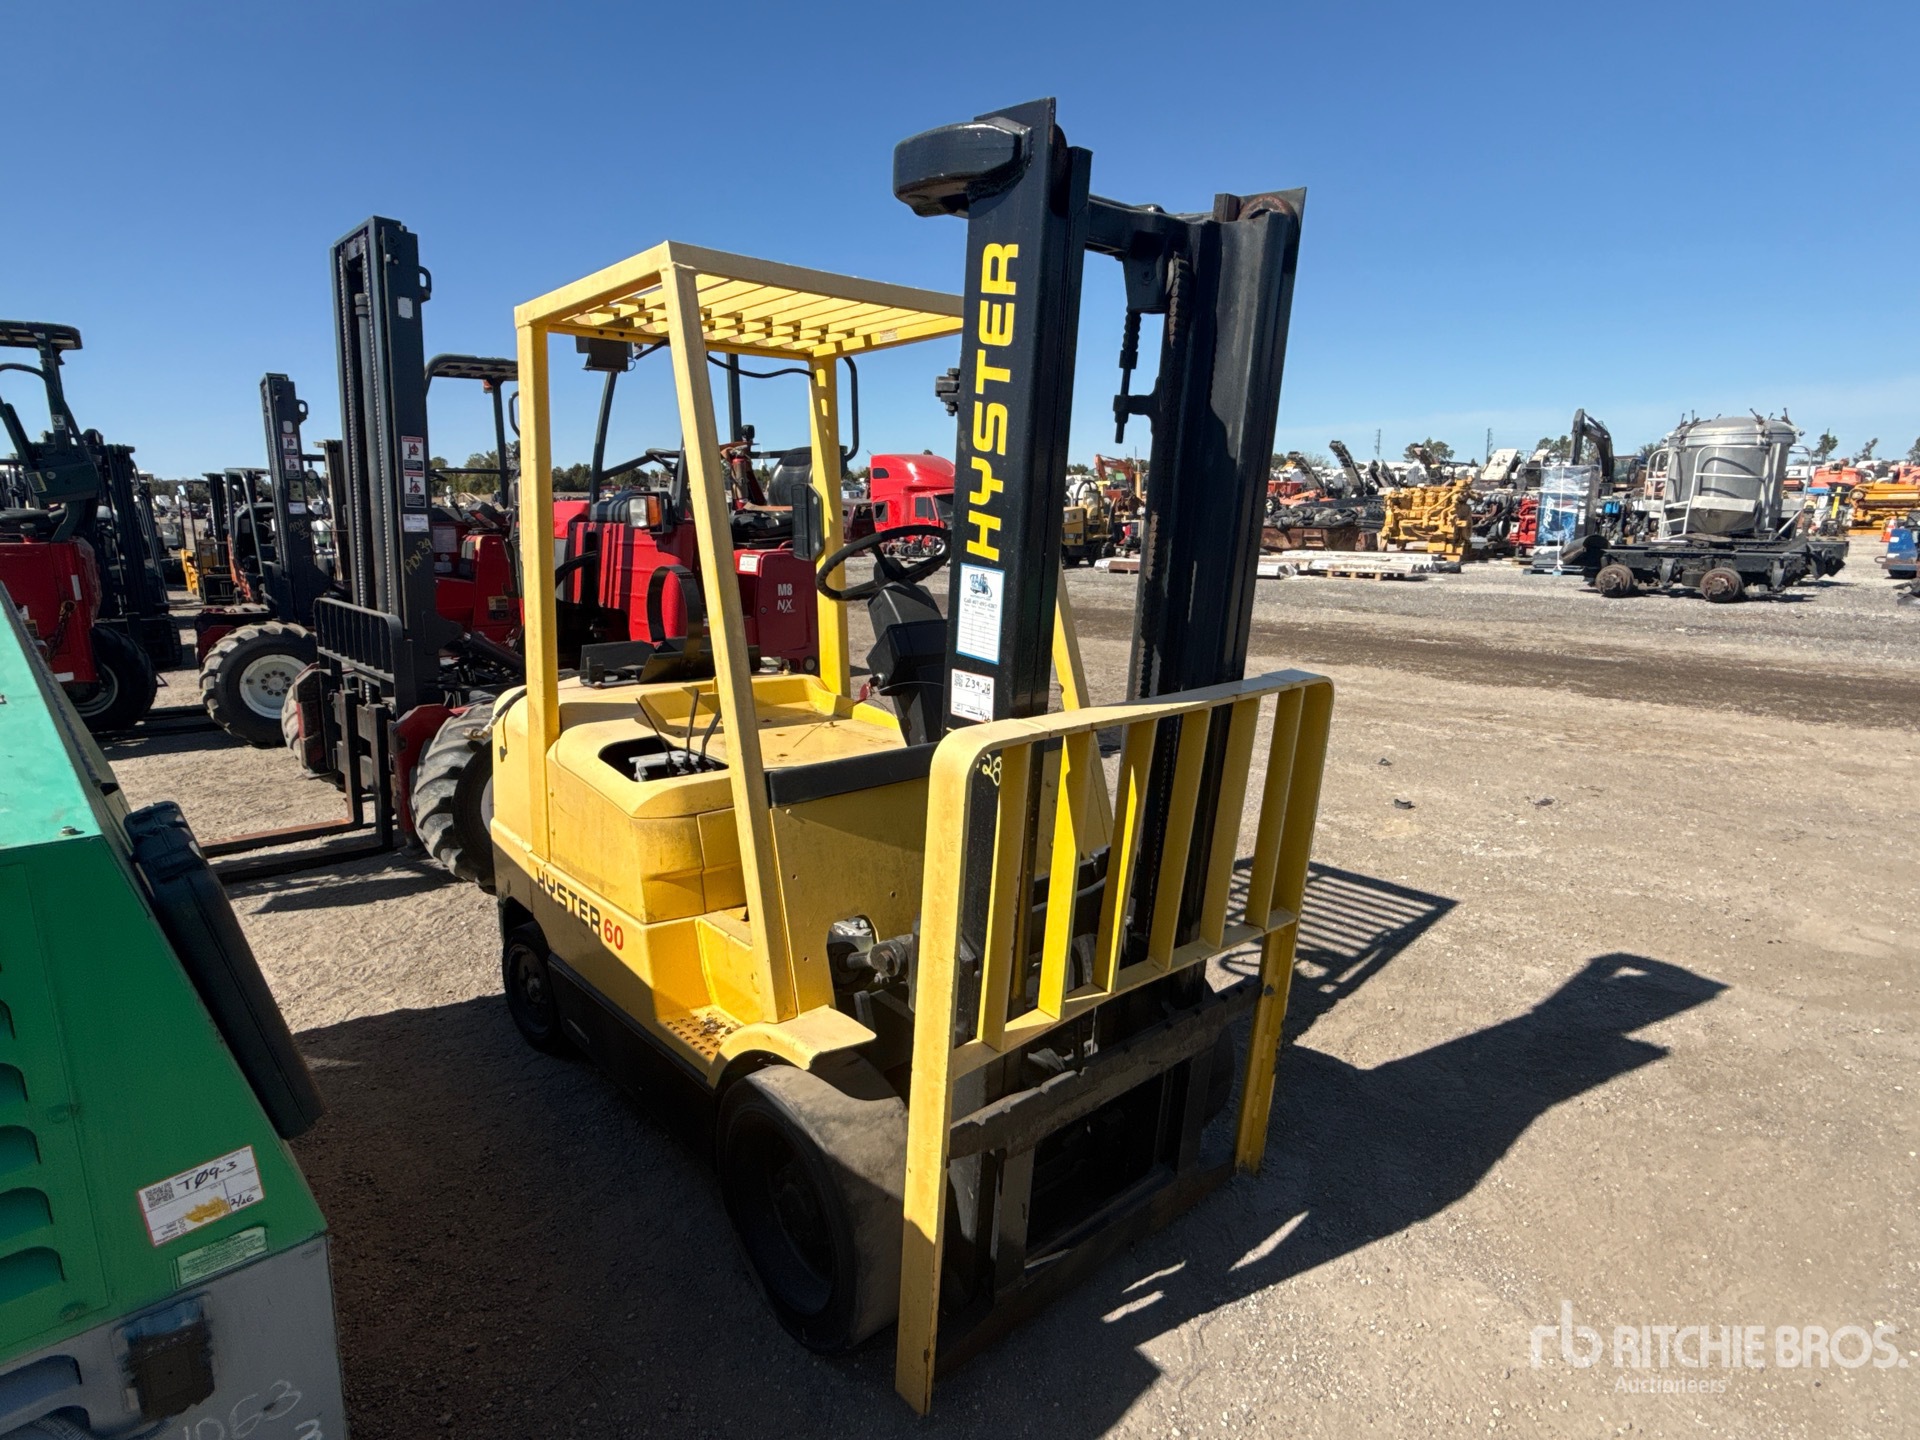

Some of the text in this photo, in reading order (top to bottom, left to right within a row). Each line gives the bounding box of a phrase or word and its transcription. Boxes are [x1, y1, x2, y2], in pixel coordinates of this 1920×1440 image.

[967, 243, 1018, 561] HYSTER
[777, 599, 792, 613] NX
[778, 584, 793, 596] M8
[536, 866, 623, 950] HYSTER 60
